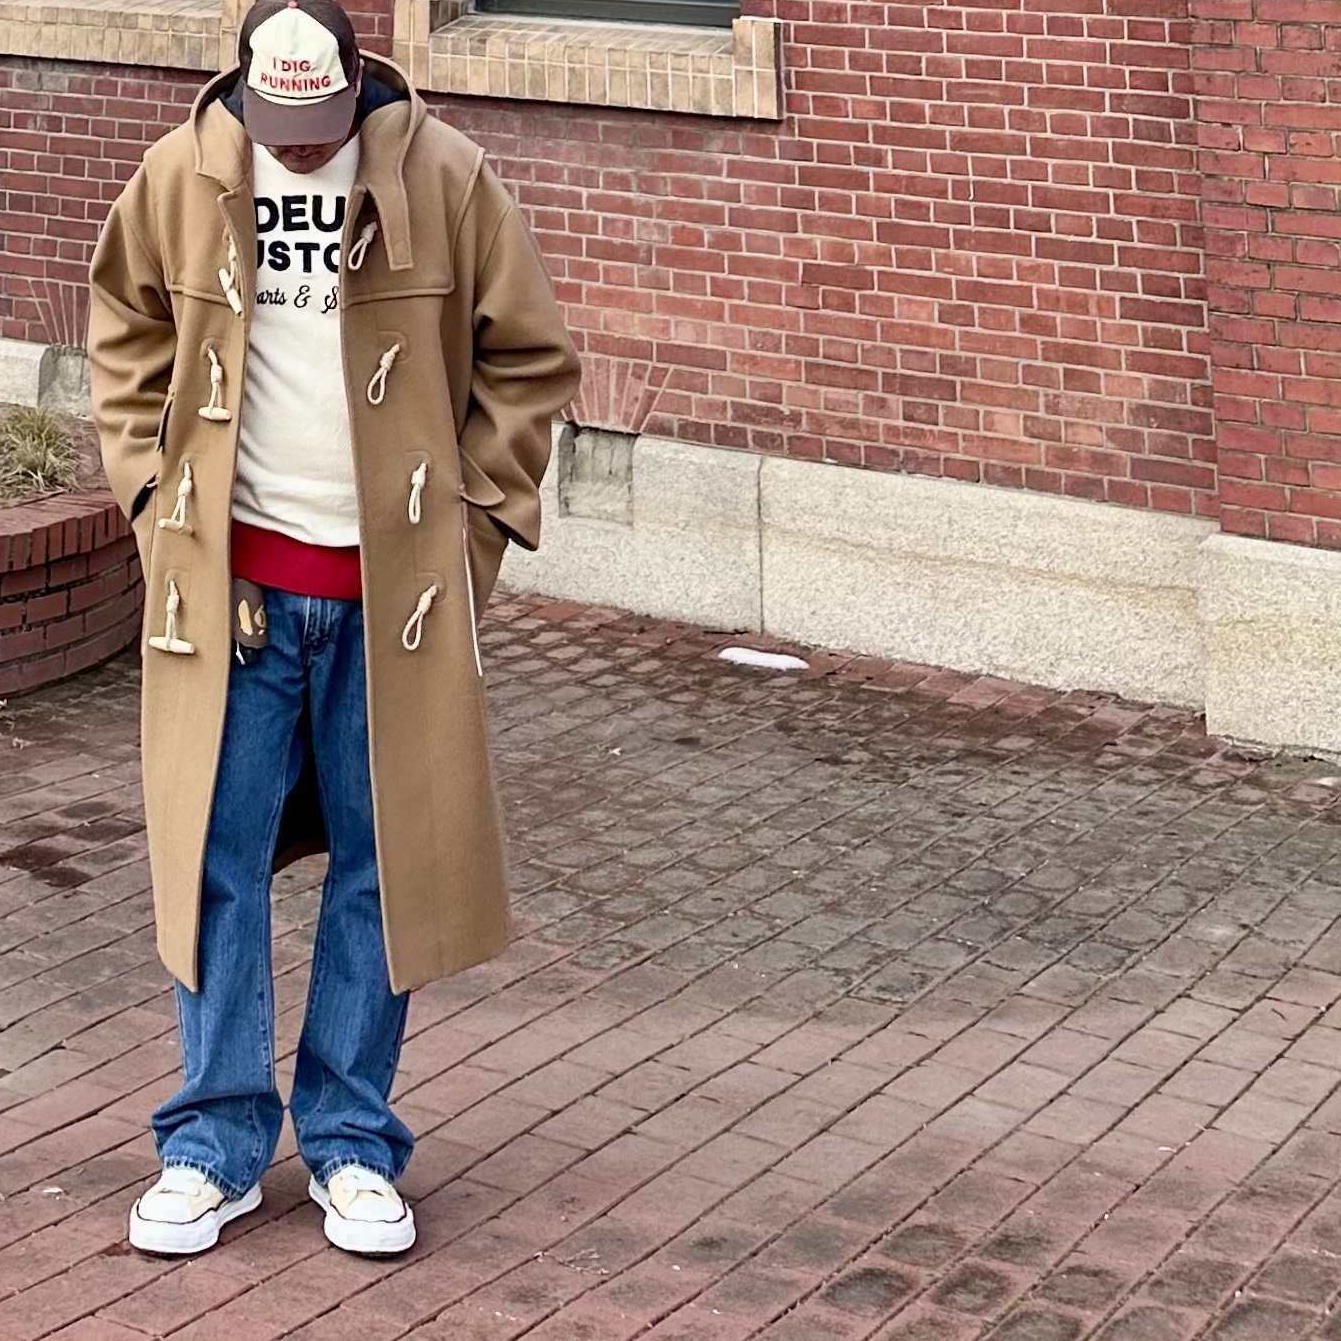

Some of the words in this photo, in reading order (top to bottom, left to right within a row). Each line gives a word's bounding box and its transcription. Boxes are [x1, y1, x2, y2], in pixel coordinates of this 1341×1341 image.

[281, 59, 311, 74] DIG
[260, 72, 331, 92] RUNNING
[254, 194, 347, 233] DEU
[293, 284, 312, 309] &
